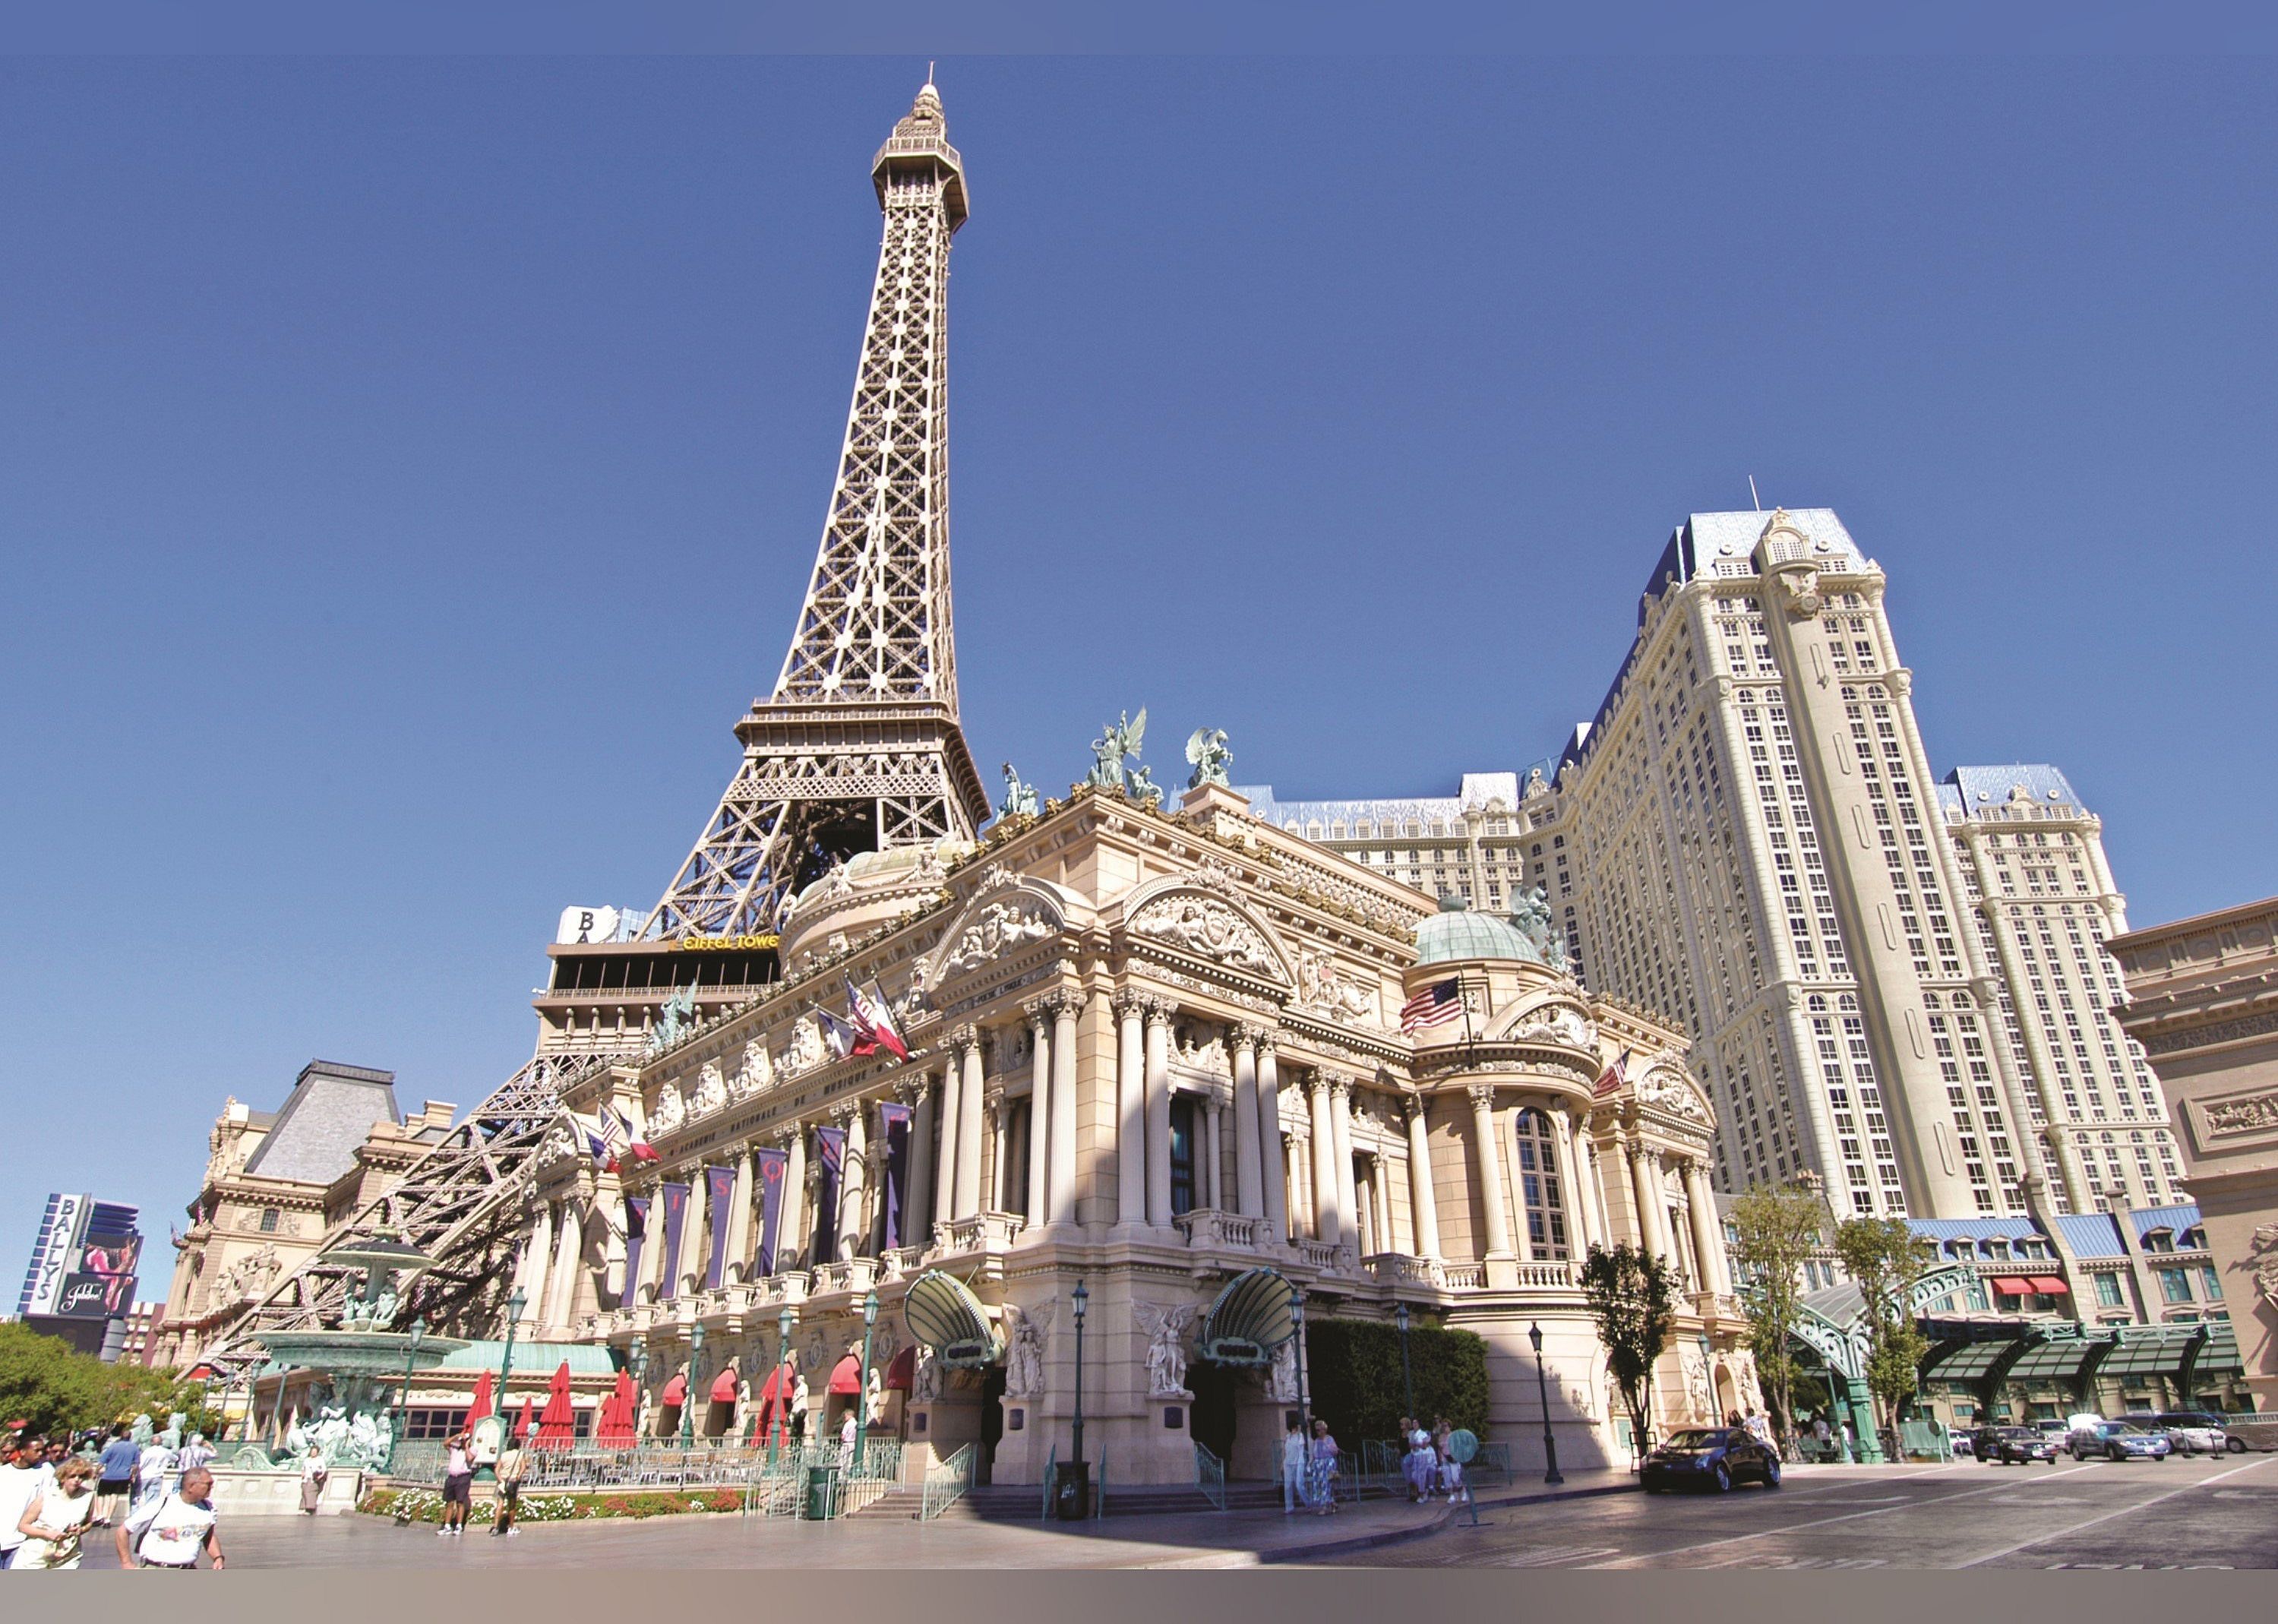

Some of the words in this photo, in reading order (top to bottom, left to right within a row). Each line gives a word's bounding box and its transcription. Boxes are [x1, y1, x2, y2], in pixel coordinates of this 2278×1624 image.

[683, 936, 732, 949] EIFFEL
[794, 1095, 806, 1107] DE
[823, 1070, 868, 1095] MUSIQUE
[715, 1178, 730, 1196] S
[762, 1160, 784, 1183] Q
